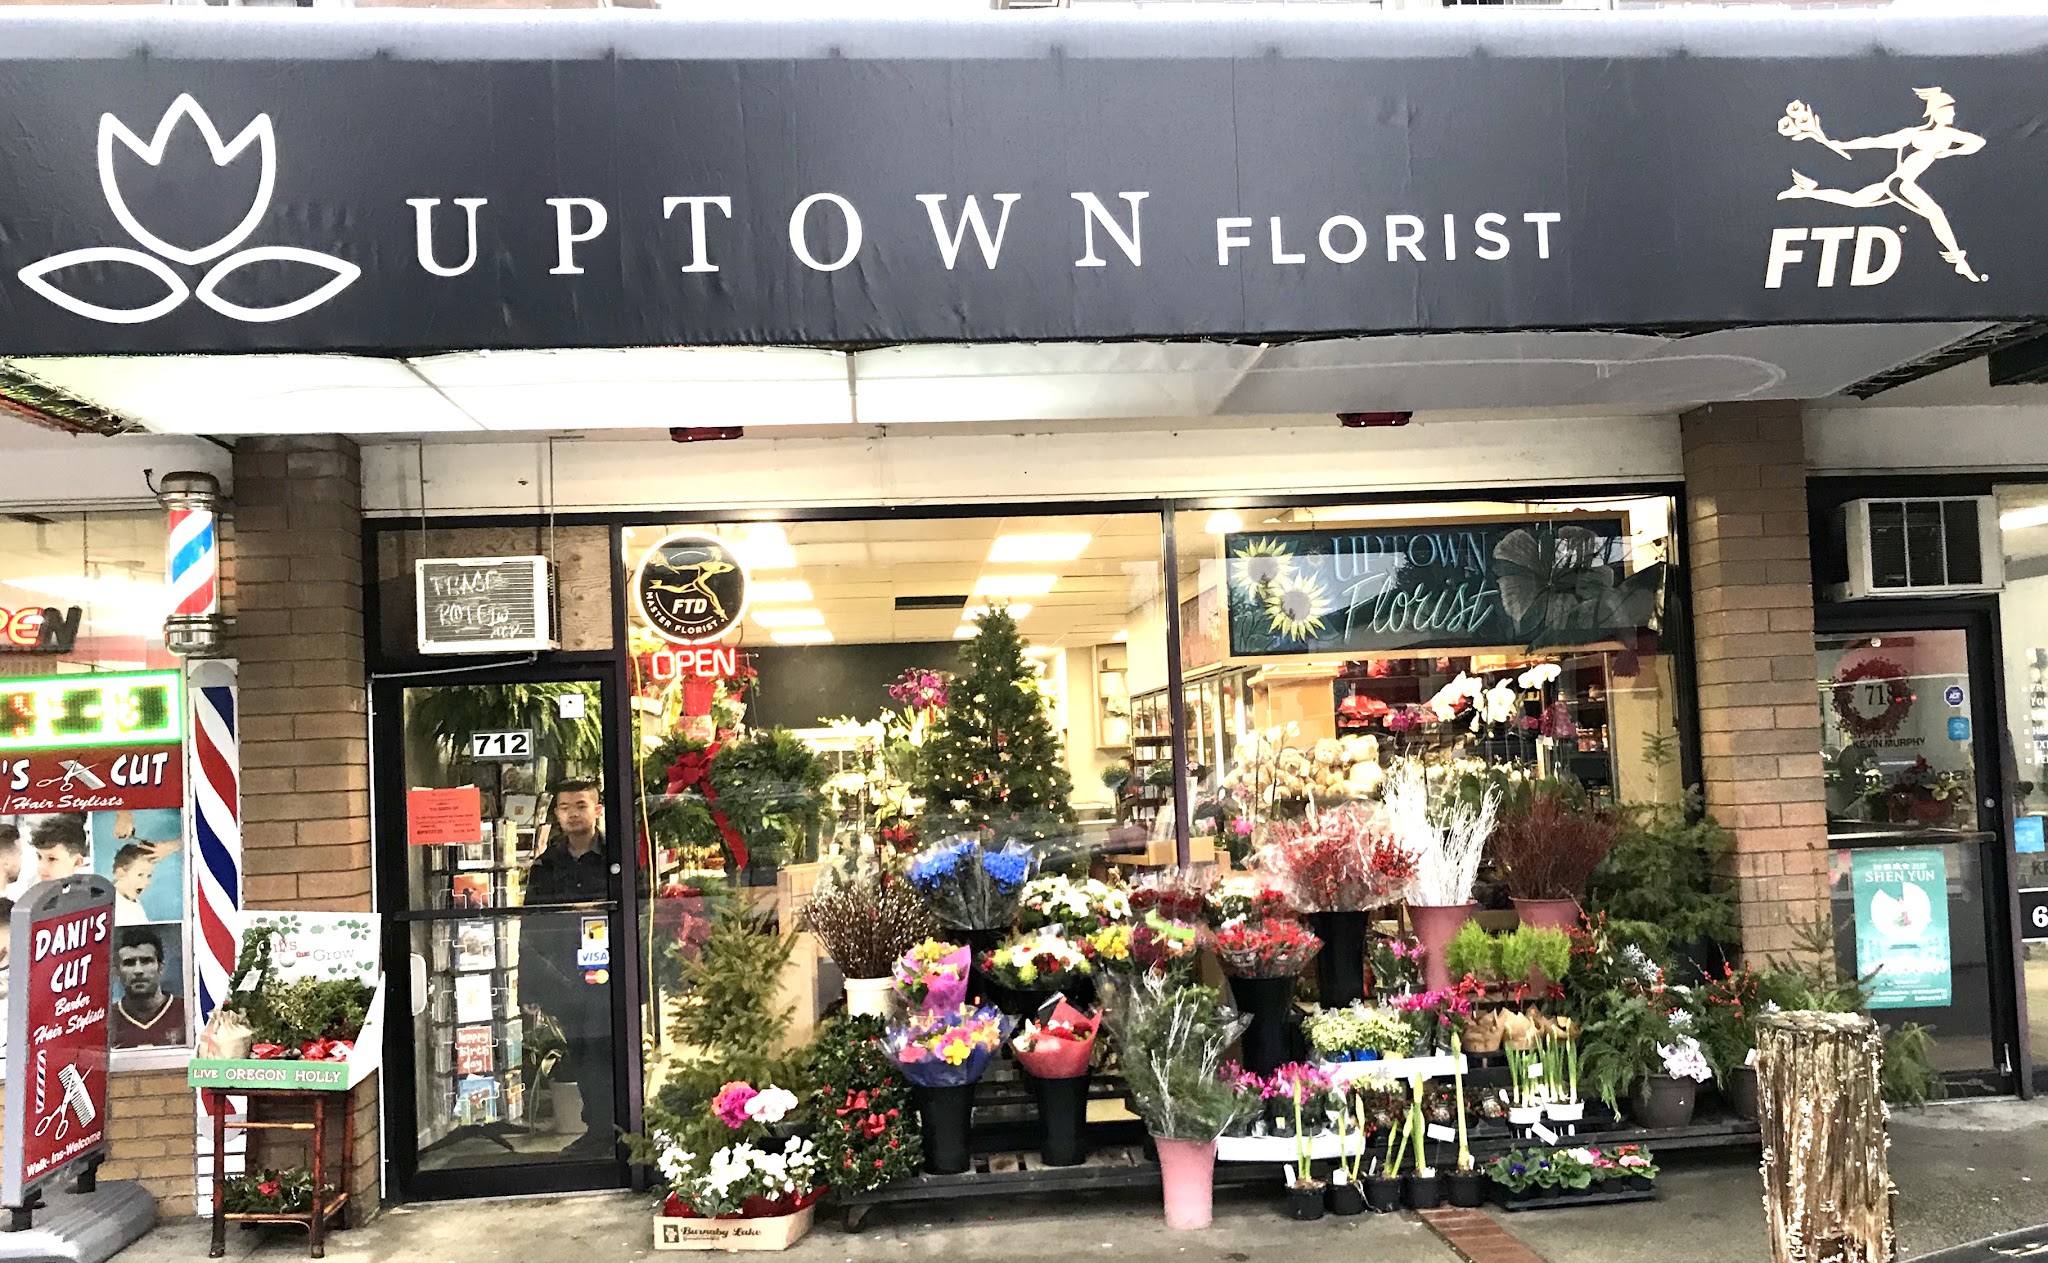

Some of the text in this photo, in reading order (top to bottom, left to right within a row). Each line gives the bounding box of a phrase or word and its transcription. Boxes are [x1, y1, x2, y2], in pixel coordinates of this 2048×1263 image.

[405, 191, 1561, 278] UPTOWN FLORIST
[1764, 225, 1903, 288] FTD
[1331, 531, 1489, 582] UPTOWN
[645, 591, 718, 635] MASTER FLORIST
[672, 598, 708, 614] FTD
[1340, 572, 1500, 644] Florist
[651, 647, 736, 681] OPEN
[475, 734, 527, 755] 712
[1885, 737, 1926, 748] MURPHY
[110, 752, 169, 787] CUT
[12, 795, 124, 810] Hair Stylists
[1865, 869, 1935, 883] SHEN YUN
[35, 911, 107, 962] DANI'S
[313, 949, 355, 962] Grow
[582, 951, 608, 962] VISA
[50, 953, 92, 993] CUT
[55, 991, 91, 1017] Barber
[33, 1007, 105, 1046] Hair Stylists
[193, 1068, 342, 1083] LIVE OREGON HOLLY
[463, 1058, 483, 1071] day
[681, 1226, 729, 1239] Burnaby
[732, 1226, 761, 1237] Lake
